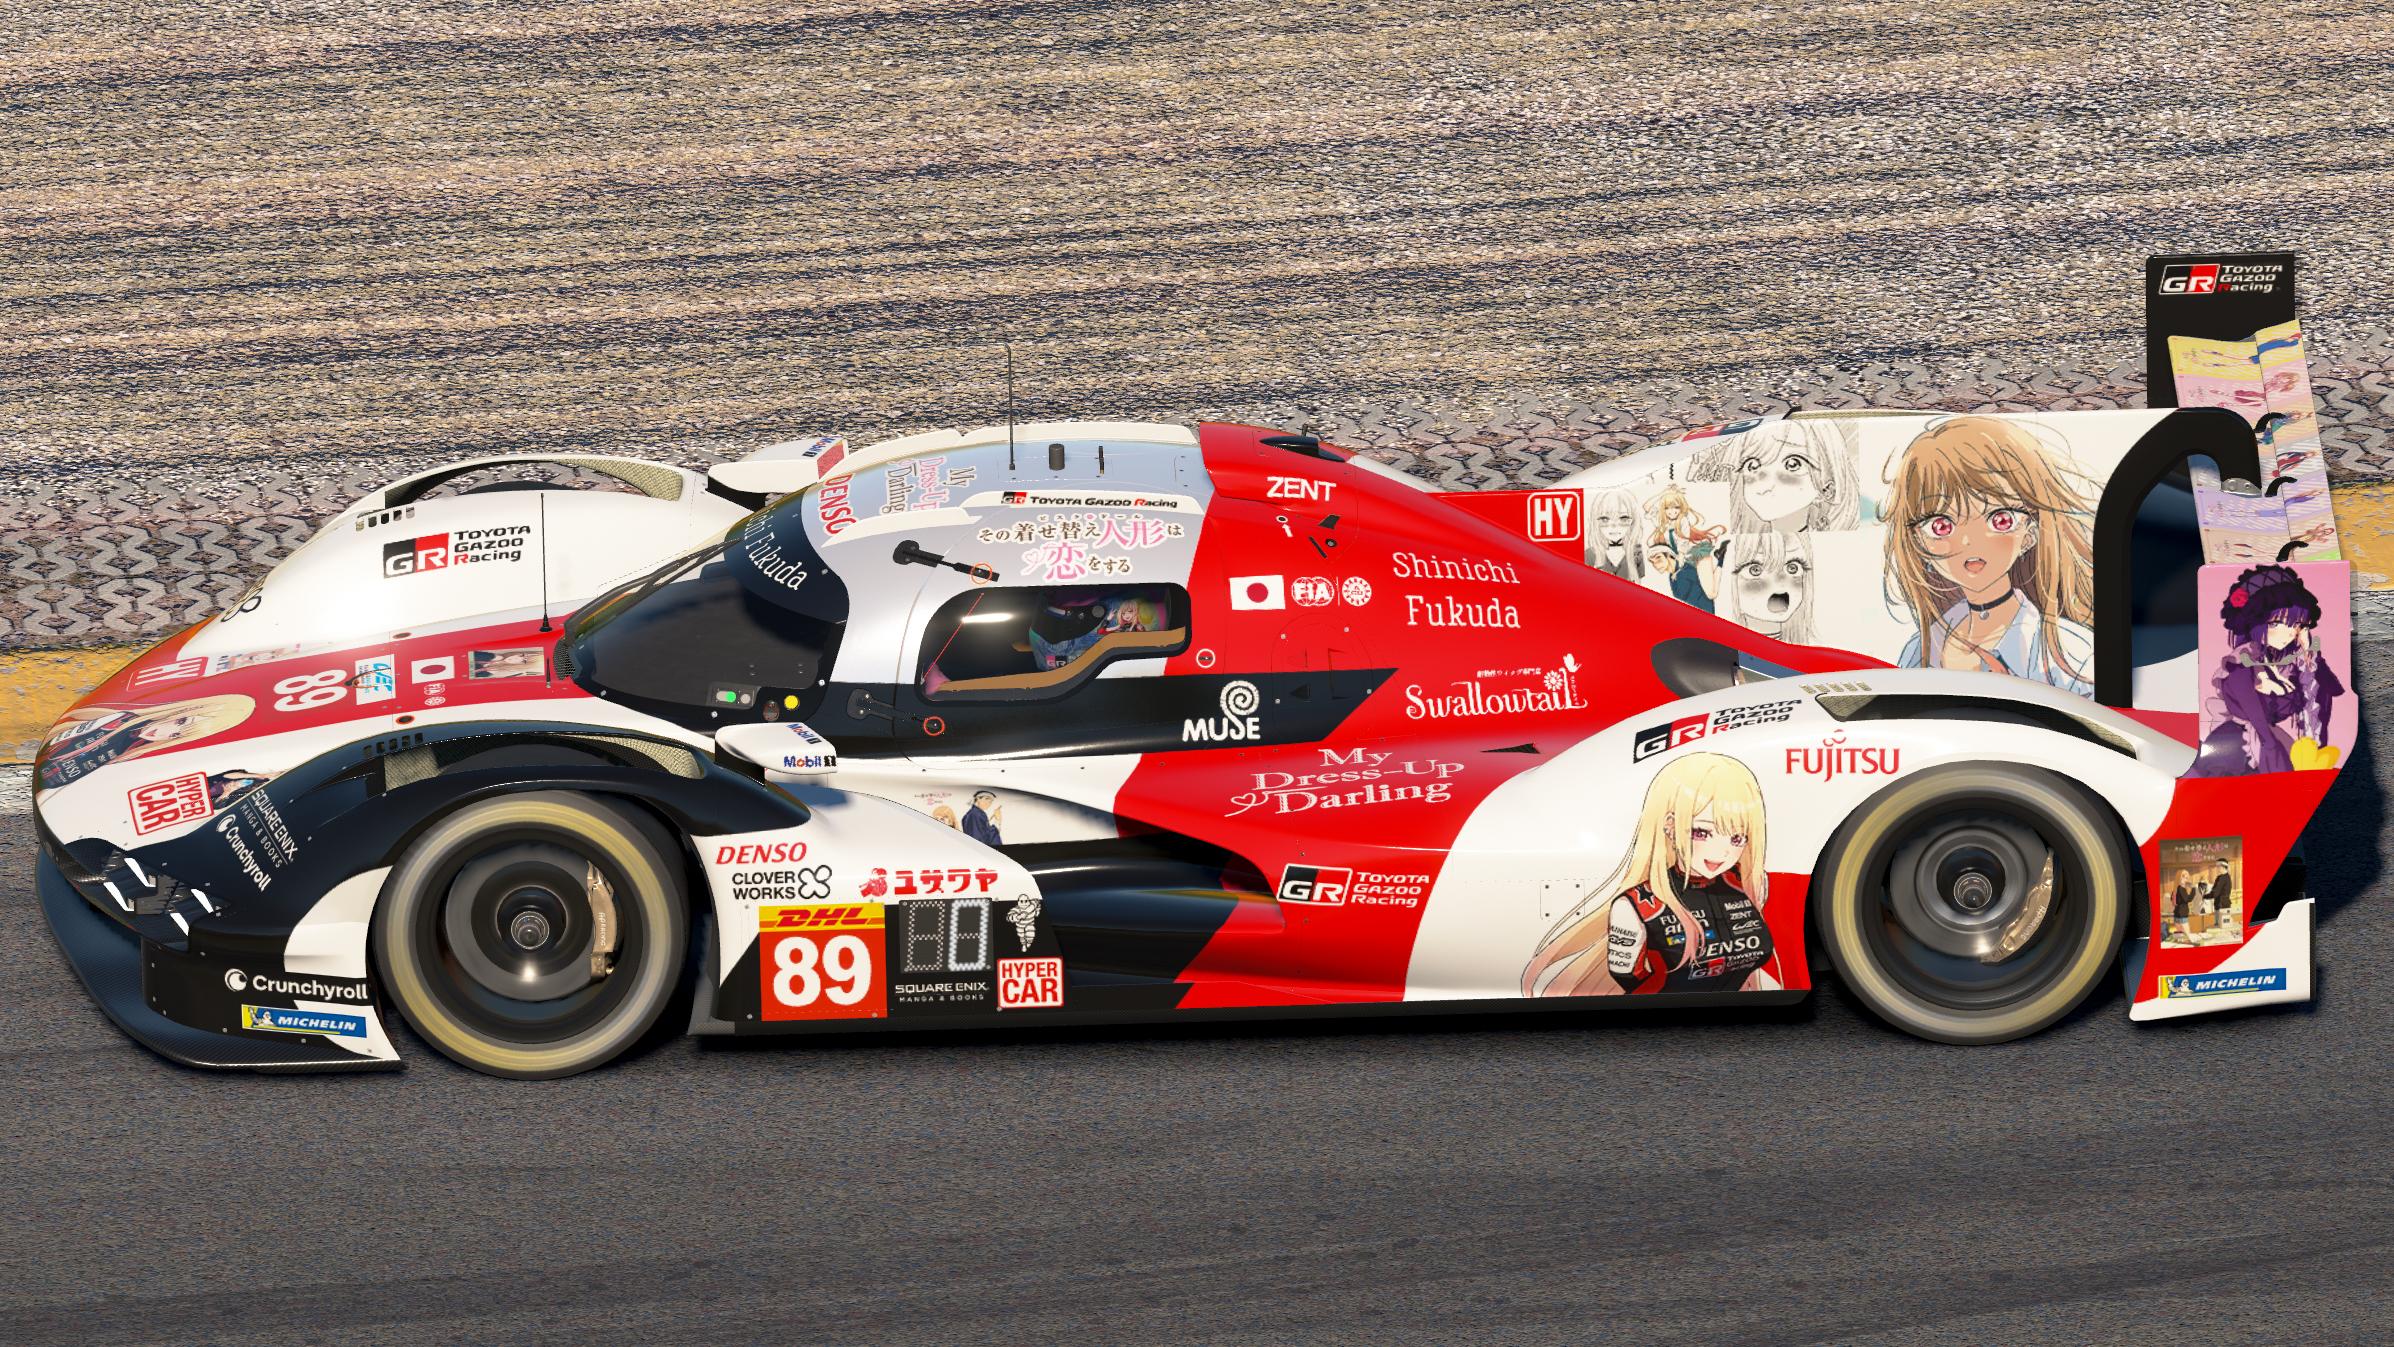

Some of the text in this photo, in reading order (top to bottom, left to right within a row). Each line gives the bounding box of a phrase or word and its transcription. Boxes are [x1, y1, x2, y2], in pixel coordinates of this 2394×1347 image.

[2219, 274, 2277, 283] GAZOO
[2222, 264, 2283, 274] TOYOTA
[2163, 275, 2215, 291] GR
[2218, 283, 2274, 294] Racing
[1266, 476, 1337, 502] ZENT
[1030, 495, 1082, 506] TOYOTA
[1084, 497, 1132, 507] GAZOO
[1133, 498, 1178, 509] Racing
[1534, 502, 1573, 537] HY
[454, 525, 531, 540] TOYOTA
[978, 519, 1184, 548] その着せ替え人形は
[453, 537, 524, 552] GAZOO
[386, 546, 447, 575] GR
[453, 549, 522, 566] Racing
[745, 532, 808, 591] Fukuda
[1044, 541, 1131, 581] 恋をする
[1393, 551, 1521, 584] Shinichi
[1294, 582, 1330, 600] FIA
[1405, 594, 1521, 629] Fukuda
[273, 669, 348, 713] 89
[1405, 666, 1588, 720] Swallowtail
[1182, 680, 1261, 742] MUSE
[1712, 707, 1794, 727] GAZOO
[1713, 699, 1803, 717] TOYOTA
[1711, 713, 1791, 735] Racing
[1635, 720, 1707, 761] GR
[783, 755, 822, 768] Mobil
[1318, 746, 1393, 768] My
[1785, 746, 1900, 783] FUJITSU
[1250, 759, 1465, 791] Dress-Up
[135, 783, 182, 833] CAR
[177, 774, 206, 819] HYPER
[1273, 780, 1453, 815] Darling
[240, 803, 260, 830] MANGA
[260, 835, 283, 868] BOOKS
[251, 789, 299, 862] SQUARE ENIX
[225, 826, 272, 892] Crunchyroll
[714, 842, 808, 866] DENSO
[731, 872, 797, 886] CLOVER
[1353, 883, 1422, 895] GAZOO
[1356, 872, 1430, 884] TOYOTA
[732, 886, 797, 900] WORKS
[1283, 879, 1346, 903] GR
[1350, 894, 1418, 909] Racing
[775, 908, 873, 928] DHL
[772, 934, 873, 1008] 89
[1001, 963, 1058, 979] HYPER
[2195, 974, 2277, 991] MICHELIN
[252, 974, 369, 1001] Crunchyroll
[894, 981, 990, 995] SQUARE ENIX
[950, 993, 985, 1002] BOOKS
[1002, 978, 1059, 1005] CAR
[277, 1015, 358, 1032] MICHELIN
